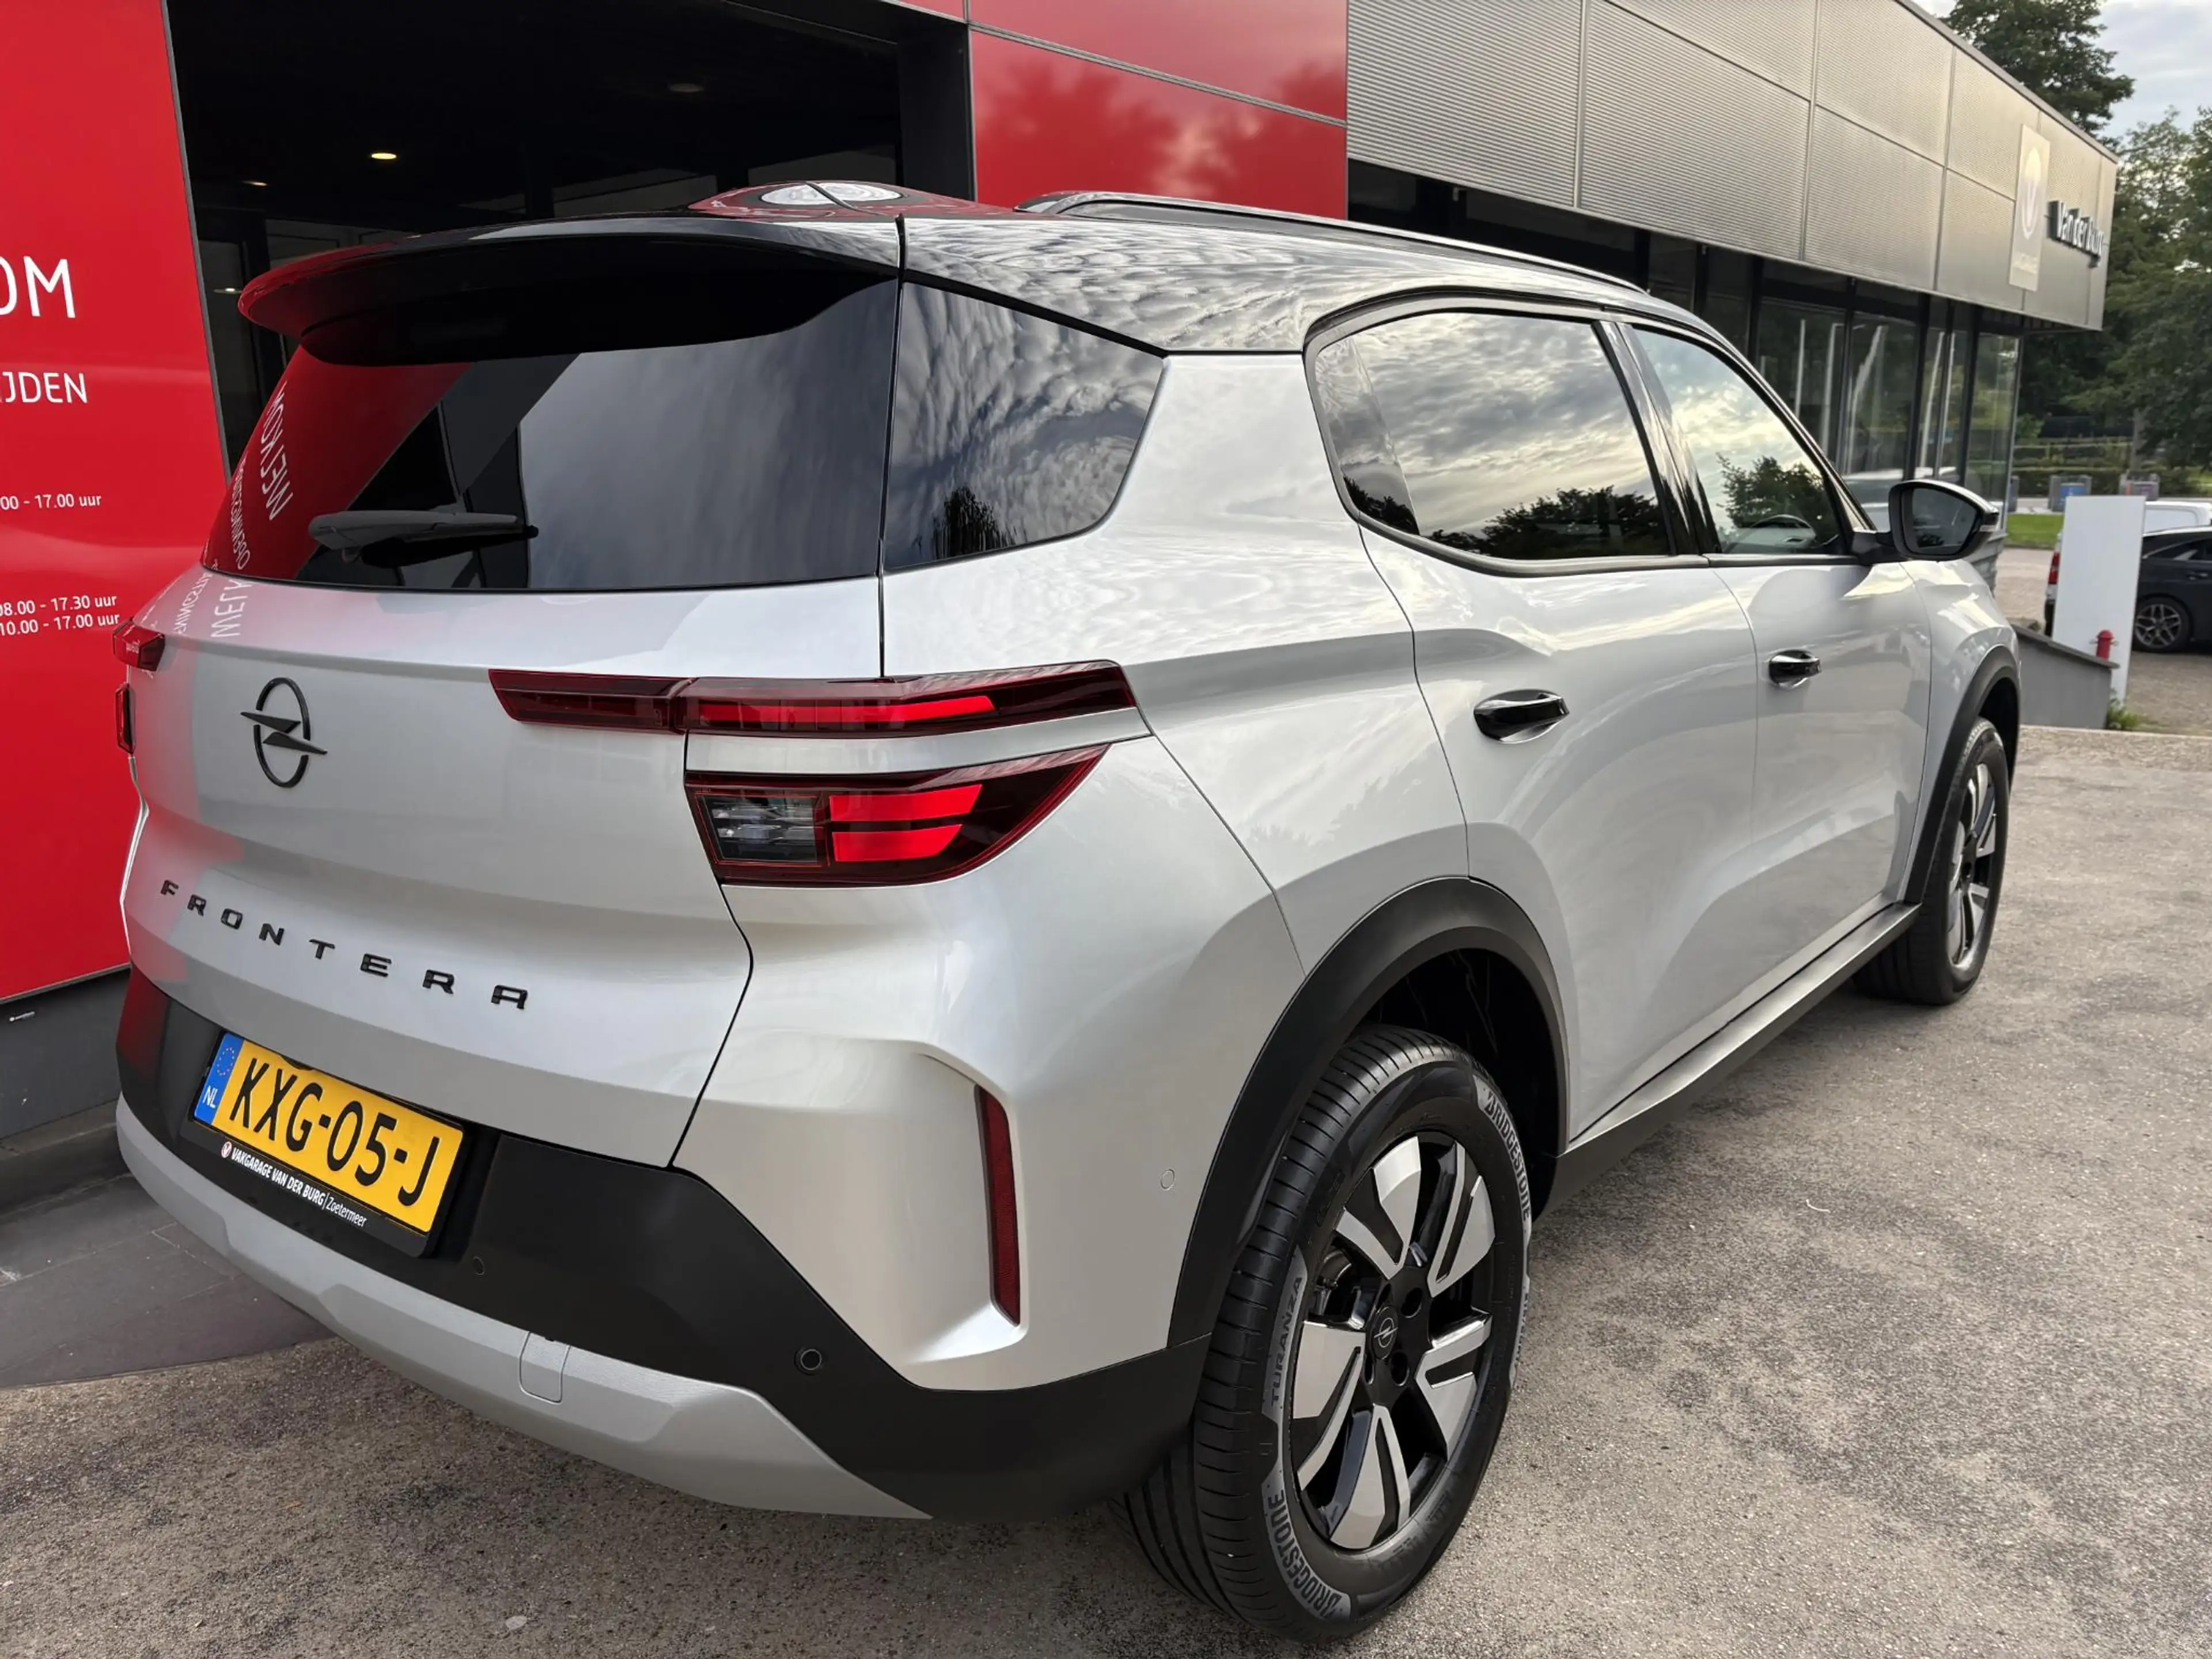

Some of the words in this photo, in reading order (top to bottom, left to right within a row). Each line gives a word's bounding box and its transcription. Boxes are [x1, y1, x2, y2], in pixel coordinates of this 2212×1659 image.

[0, 371, 88, 403] JDEN
[35, 494, 74, 509] 17.00
[79, 495, 101, 507] uur
[51, 595, 90, 611] 17.30
[95, 596, 118, 608] uur
[54, 613, 93, 630] 17.00
[97, 614, 120, 626] uur
[160, 879, 528, 1010] FRONTERA
[202, 1086, 217, 1109] NL
[229, 1058, 440, 1207] KXG-05-J
[1484, 1090, 1530, 1221] BRIDGESTONE
[231, 1147, 274, 1179] VAKGARAGE
[271, 1168, 288, 1187] VAN
[286, 1175, 304, 1197] DER
[302, 1184, 327, 1206] BURG
[1271, 1277, 1302, 1407] TURANZA
[1268, 1489, 1342, 1618] BRIDGESTONE
